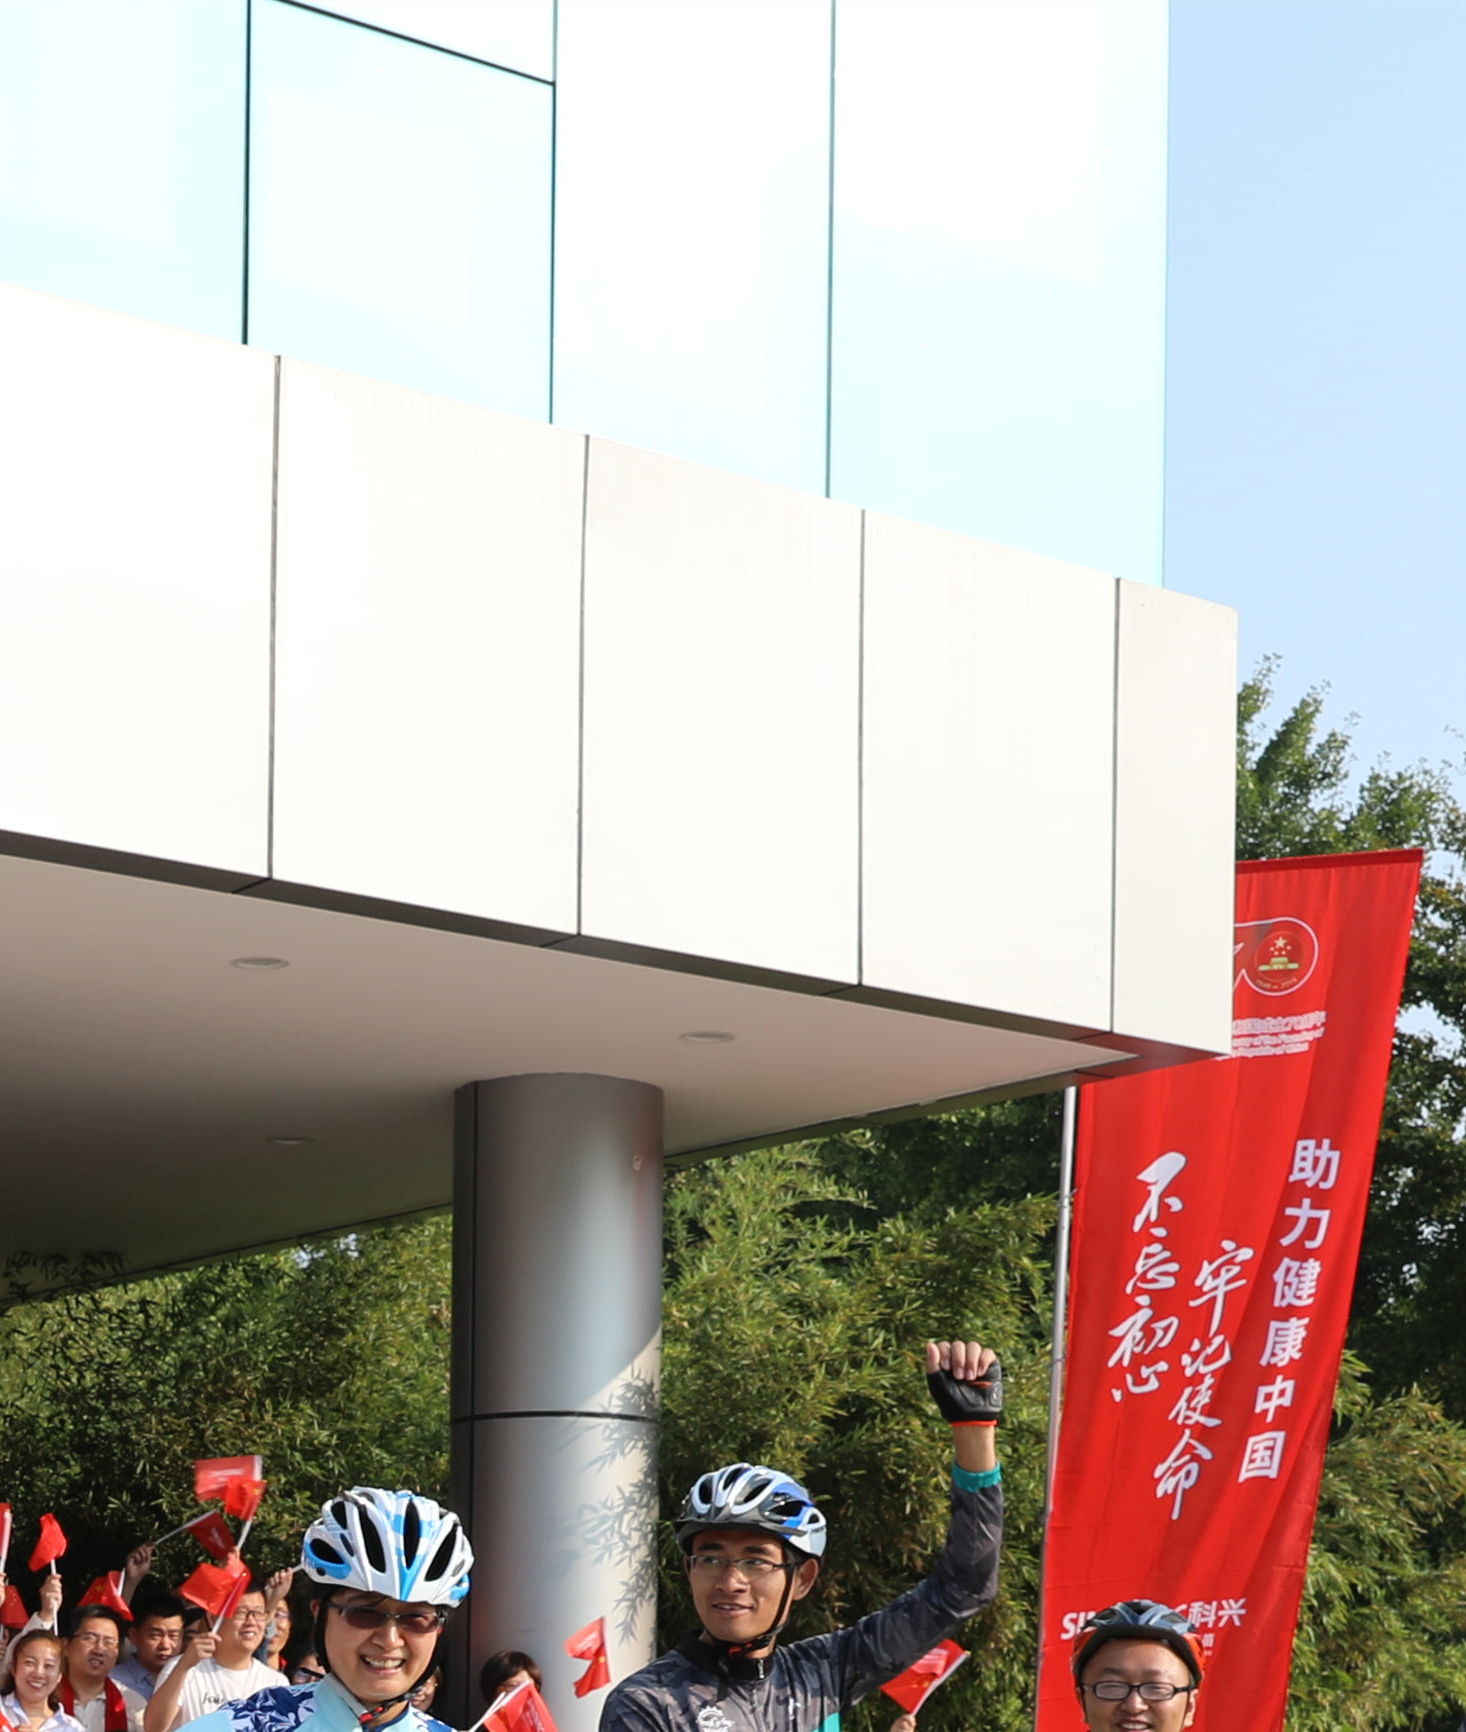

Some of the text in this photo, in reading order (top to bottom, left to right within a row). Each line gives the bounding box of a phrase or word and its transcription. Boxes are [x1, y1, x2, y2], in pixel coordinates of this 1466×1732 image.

[1107, 1151, 1186, 1402] 不忘初心
[1153, 1240, 1254, 1520] 牢记使命
[1238, 1138, 1340, 1483] 助力健康中国
